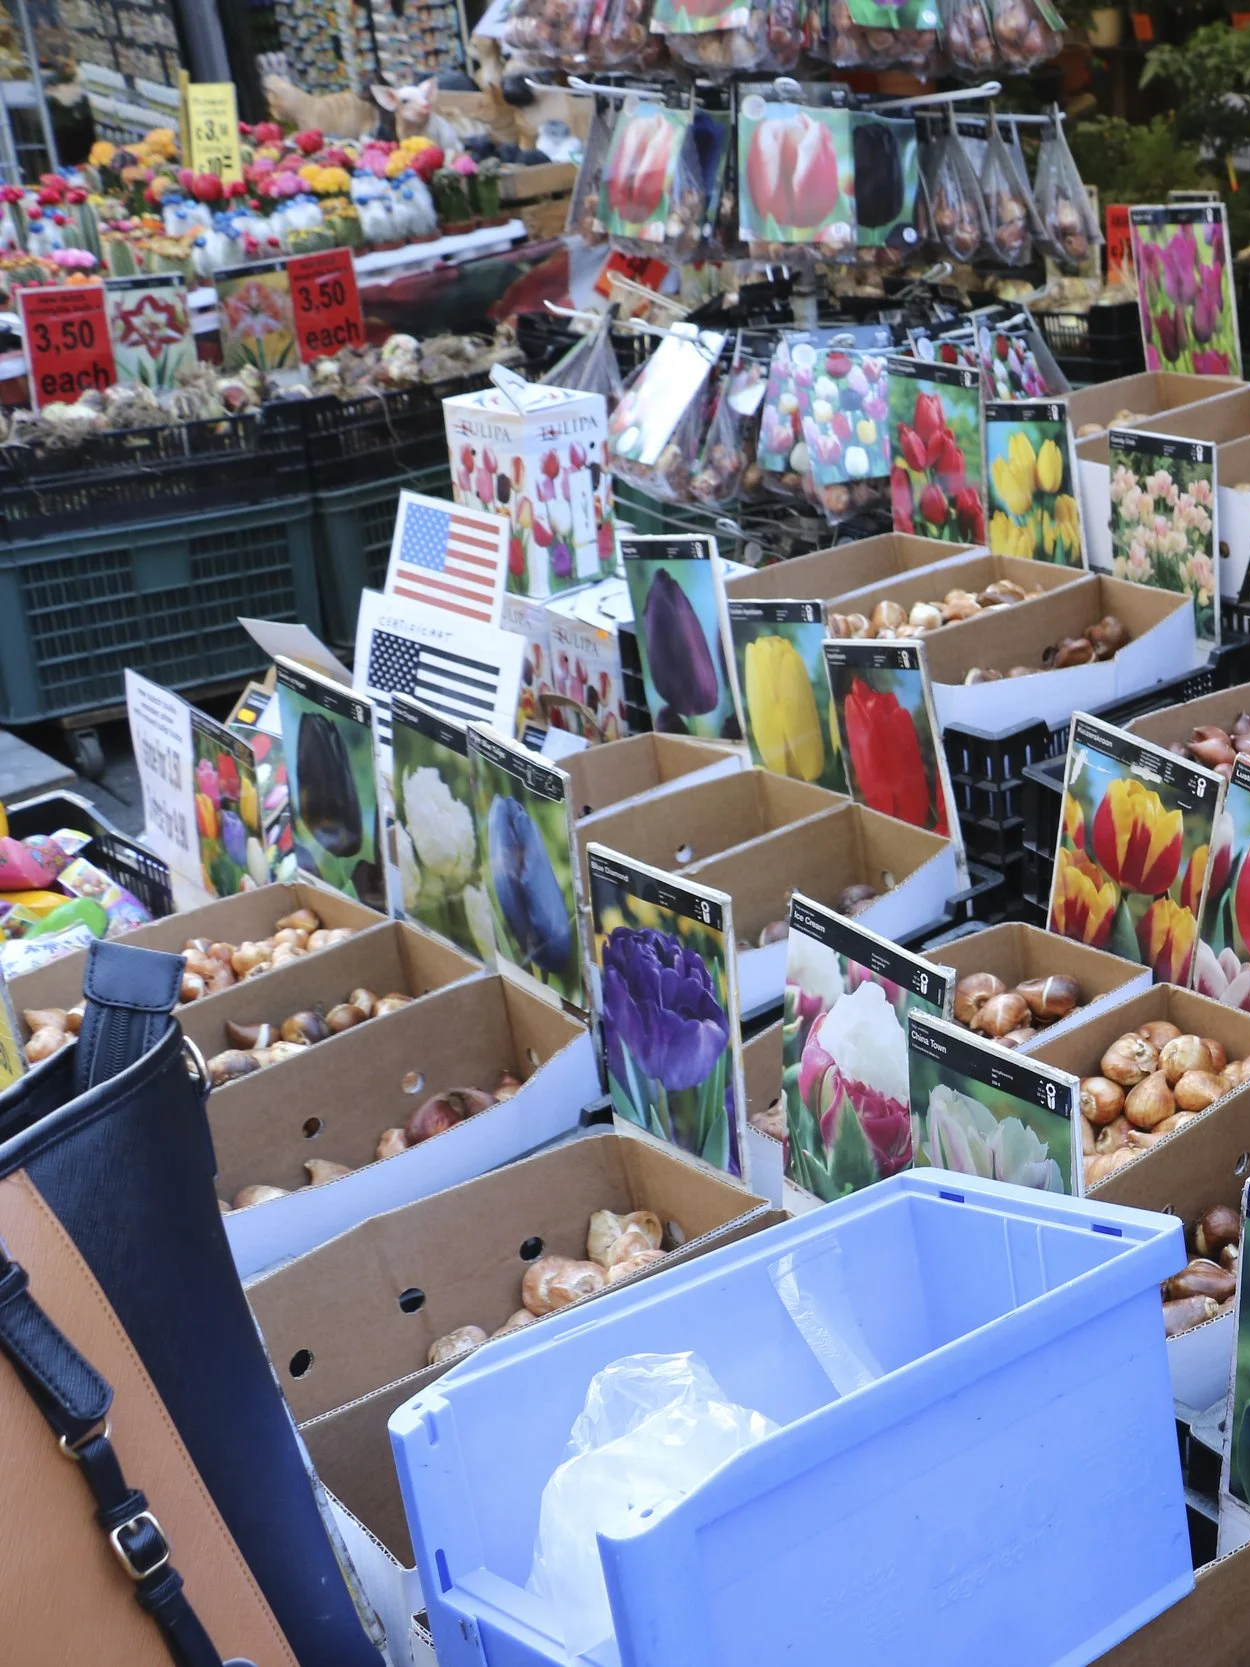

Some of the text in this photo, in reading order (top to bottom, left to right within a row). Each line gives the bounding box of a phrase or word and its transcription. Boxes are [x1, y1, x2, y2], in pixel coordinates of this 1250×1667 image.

[298, 279, 346, 314] 3,50
[33, 320, 95, 355] 3,50
[305, 317, 361, 350] each
[40, 362, 112, 396] each
[454, 419, 512, 442] TULIPA
[539, 415, 599, 441] TULIPA
[591, 861, 629, 882] Blue Diamond
[794, 911, 804, 923] Ice
[805, 916, 826, 933] Cream
[911, 1030, 929, 1047] China
[930, 1039, 947, 1054] Town
